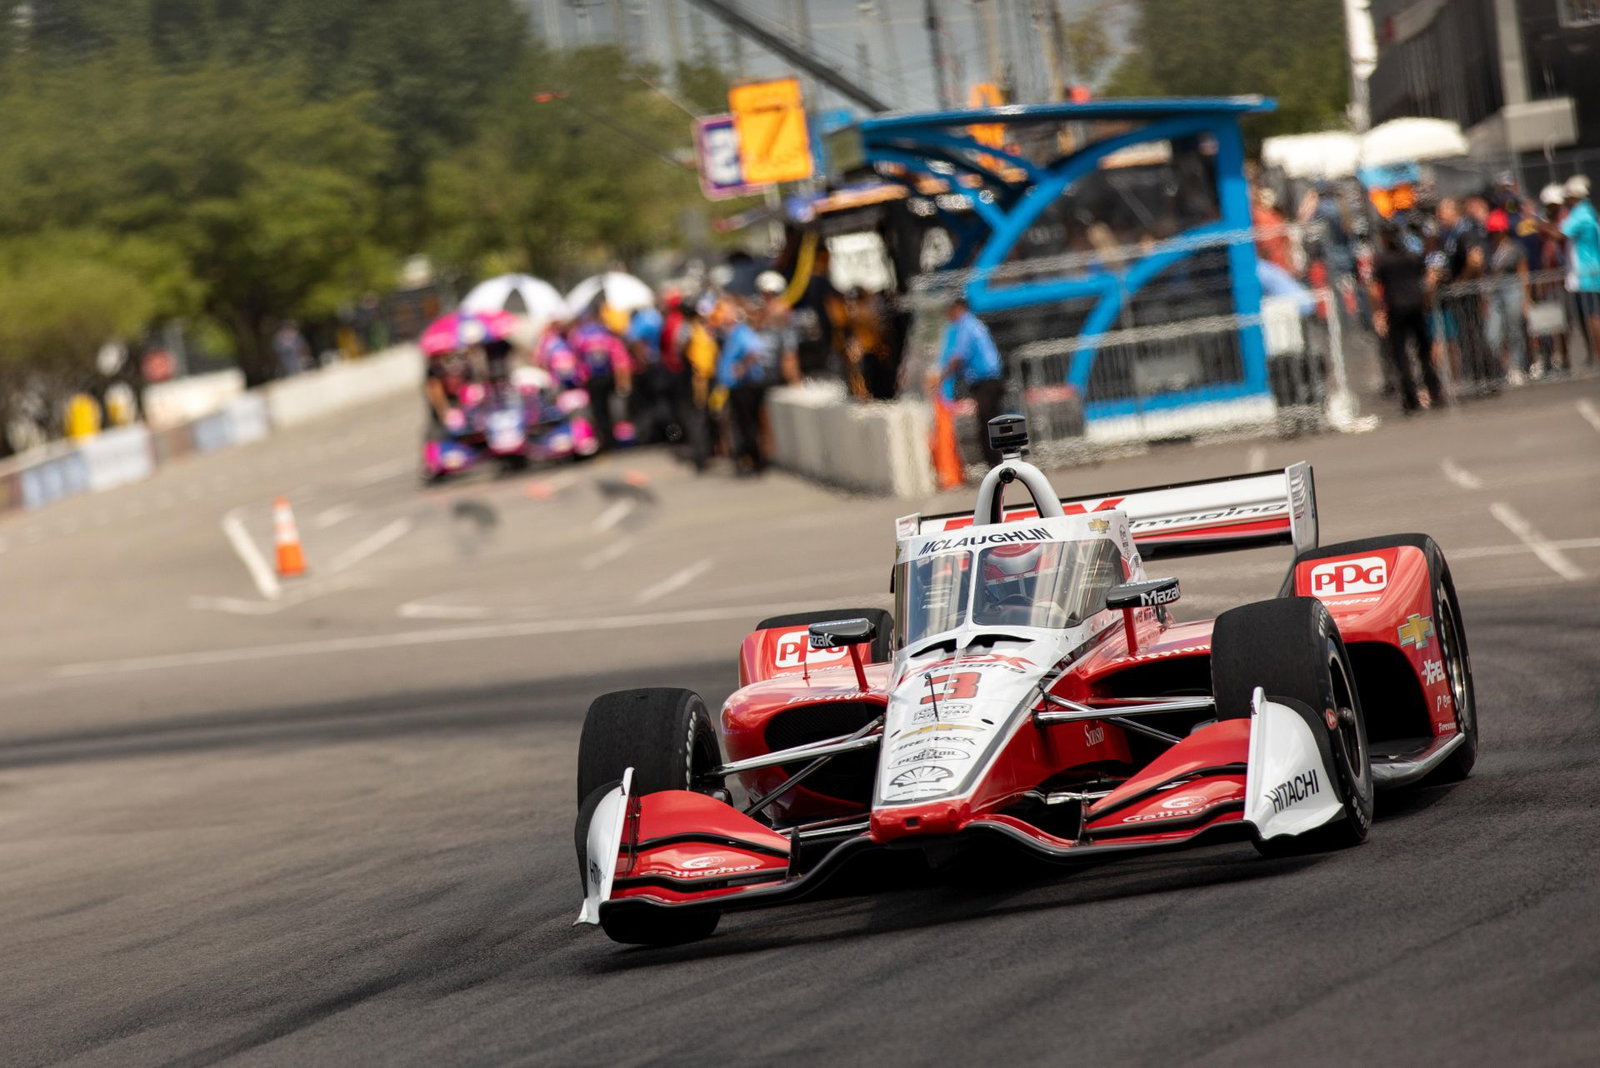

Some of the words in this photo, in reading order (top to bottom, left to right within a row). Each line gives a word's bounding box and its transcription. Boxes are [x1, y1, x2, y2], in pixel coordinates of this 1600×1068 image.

[752, 105, 788, 161] 7
[918, 527, 1054, 555] MCLAUGHLIN
[1315, 564, 1384, 592] PPG
[920, 672, 982, 705] 3
[1264, 769, 1319, 814] HITACHI
